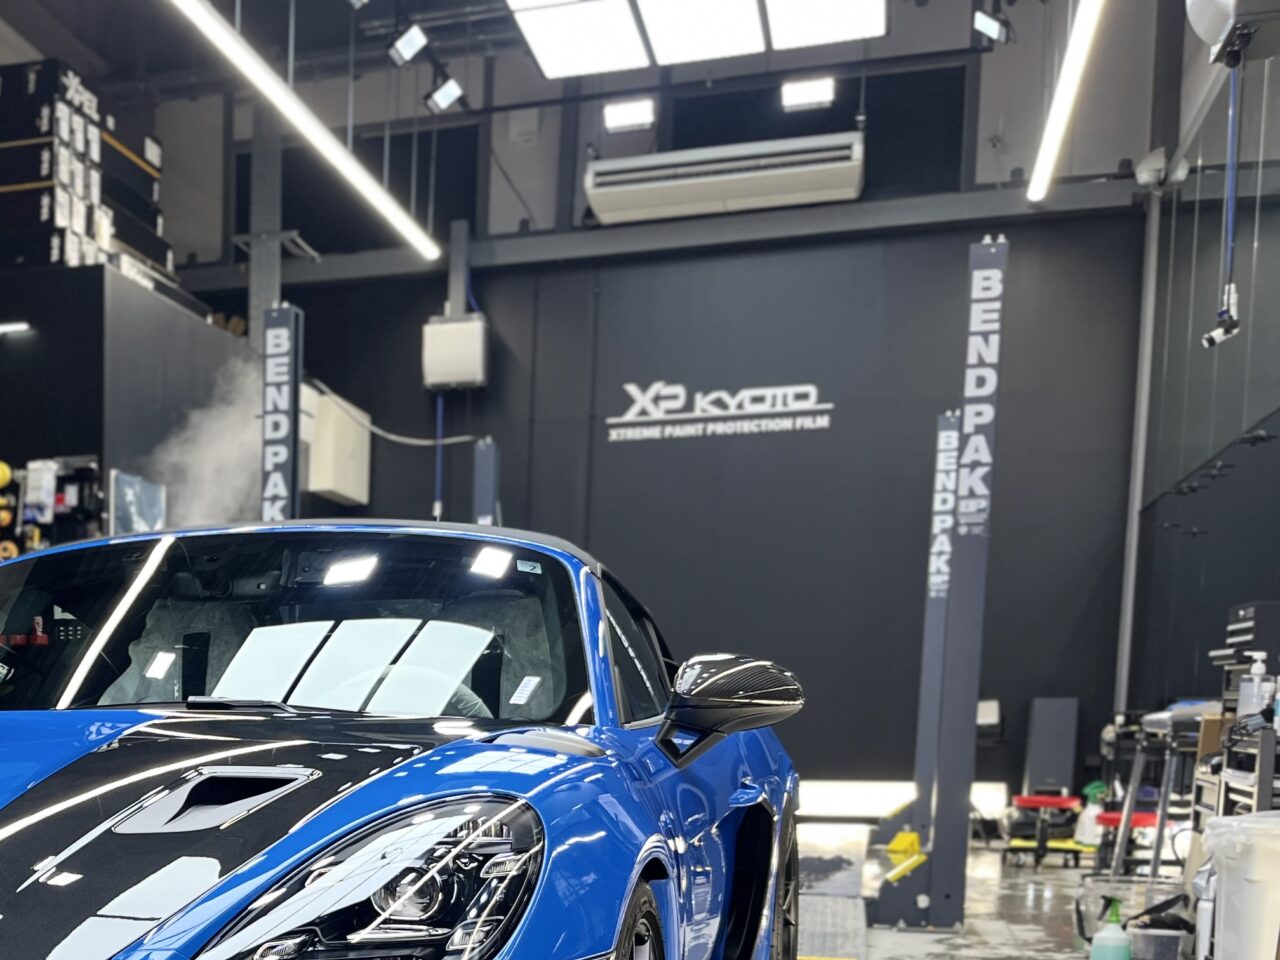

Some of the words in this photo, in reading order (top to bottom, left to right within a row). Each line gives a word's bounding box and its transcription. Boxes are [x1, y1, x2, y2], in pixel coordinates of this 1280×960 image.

[262, 327, 291, 522] BENDPAK
[608, 425, 662, 442] XTREME
[664, 422, 704, 438] PAINT
[706, 416, 793, 436] PROTECTION
[795, 414, 830, 431] FILM
[623, 381, 687, 420] XP
[694, 384, 818, 415] KYOTO
[957, 268, 1004, 497] BENDPAK
[928, 430, 959, 574] BENDPAK
